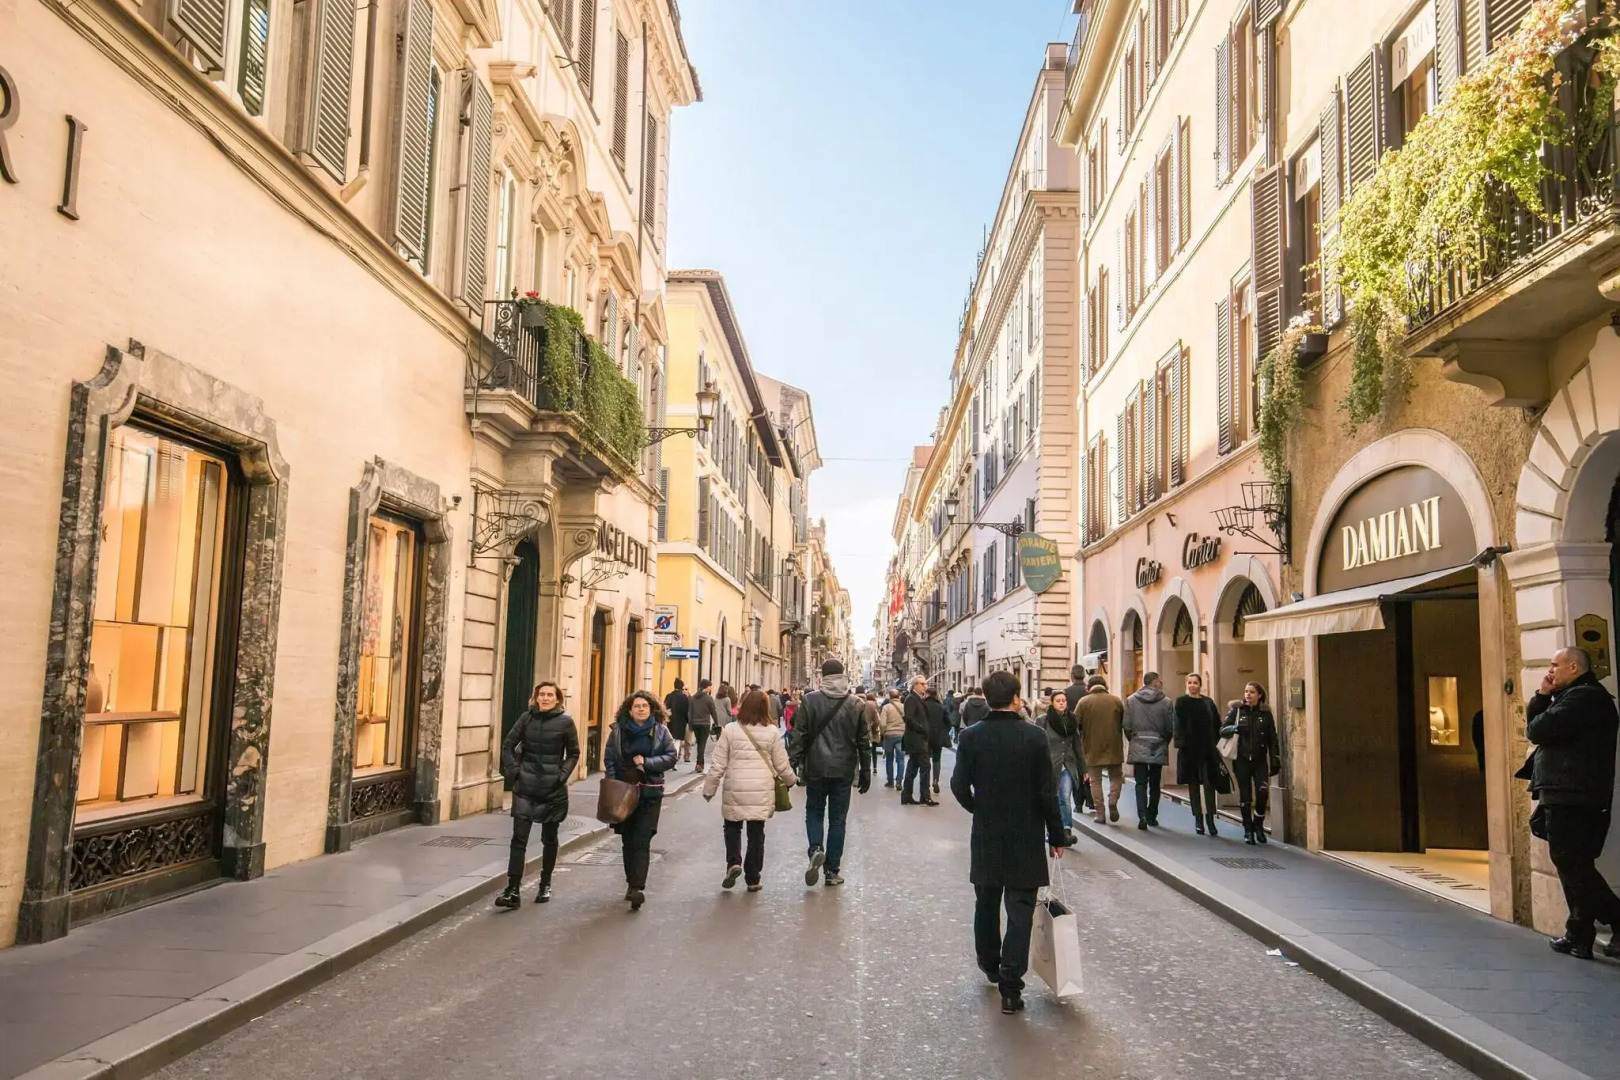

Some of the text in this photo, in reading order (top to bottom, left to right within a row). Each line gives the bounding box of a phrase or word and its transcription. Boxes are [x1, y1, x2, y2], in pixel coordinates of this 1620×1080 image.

[597, 520, 648, 574] NGELETTI
[1182, 533, 1221, 570] Cartier
[1341, 496, 1442, 571] DAMIANI
[1136, 557, 1162, 589] Cartier
